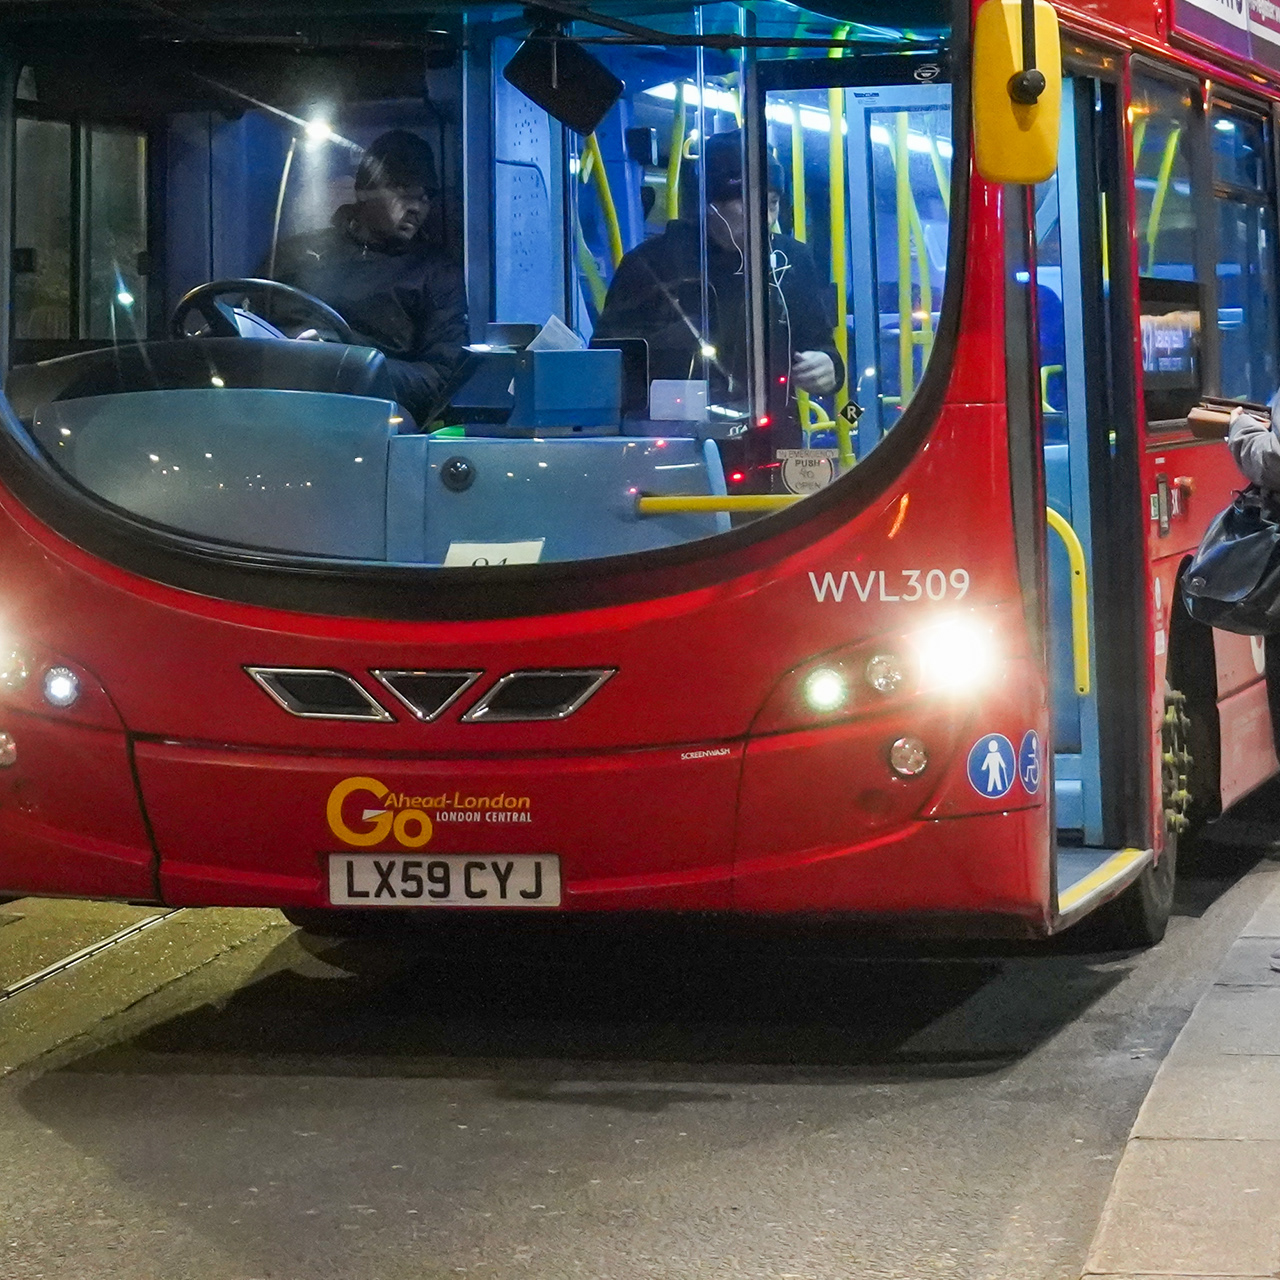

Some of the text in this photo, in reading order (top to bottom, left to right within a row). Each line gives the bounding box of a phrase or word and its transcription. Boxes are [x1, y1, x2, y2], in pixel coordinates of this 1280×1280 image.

[846, 405, 858, 419] R
[795, 459, 820, 468] PUSH
[807, 568, 970, 603] WVL309
[680, 747, 731, 760] SCREENWASH
[326, 775, 531, 848] Go Ahead-London
[436, 810, 532, 823] LONDON CENTRAL
[345, 859, 543, 900] LX59 CYJ
